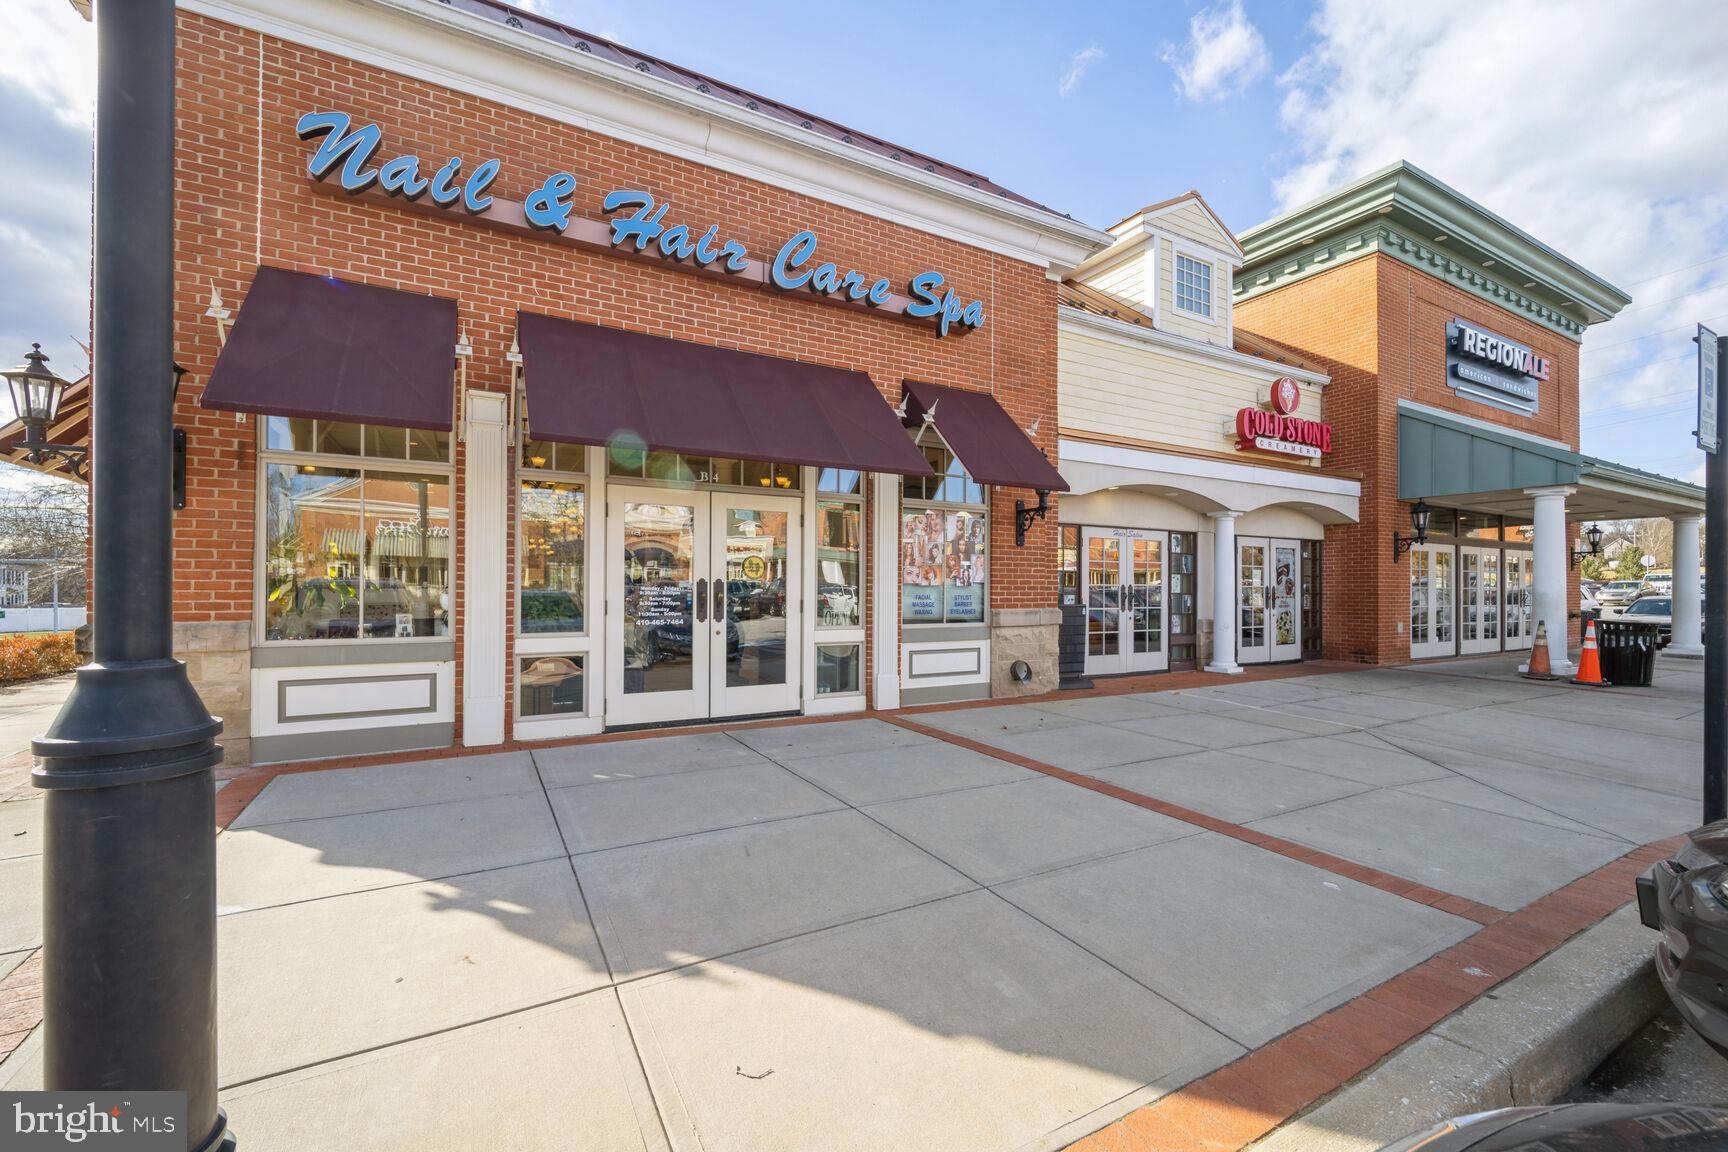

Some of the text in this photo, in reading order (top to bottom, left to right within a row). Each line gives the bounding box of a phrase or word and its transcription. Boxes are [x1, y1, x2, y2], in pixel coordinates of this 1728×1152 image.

[296, 110, 987, 339] Nail & Hair Care Spa
[1460, 326, 1551, 382] REGIONALE
[1240, 406, 1332, 454] COLD STONE
[1259, 439, 1318, 456] CREAMERY
